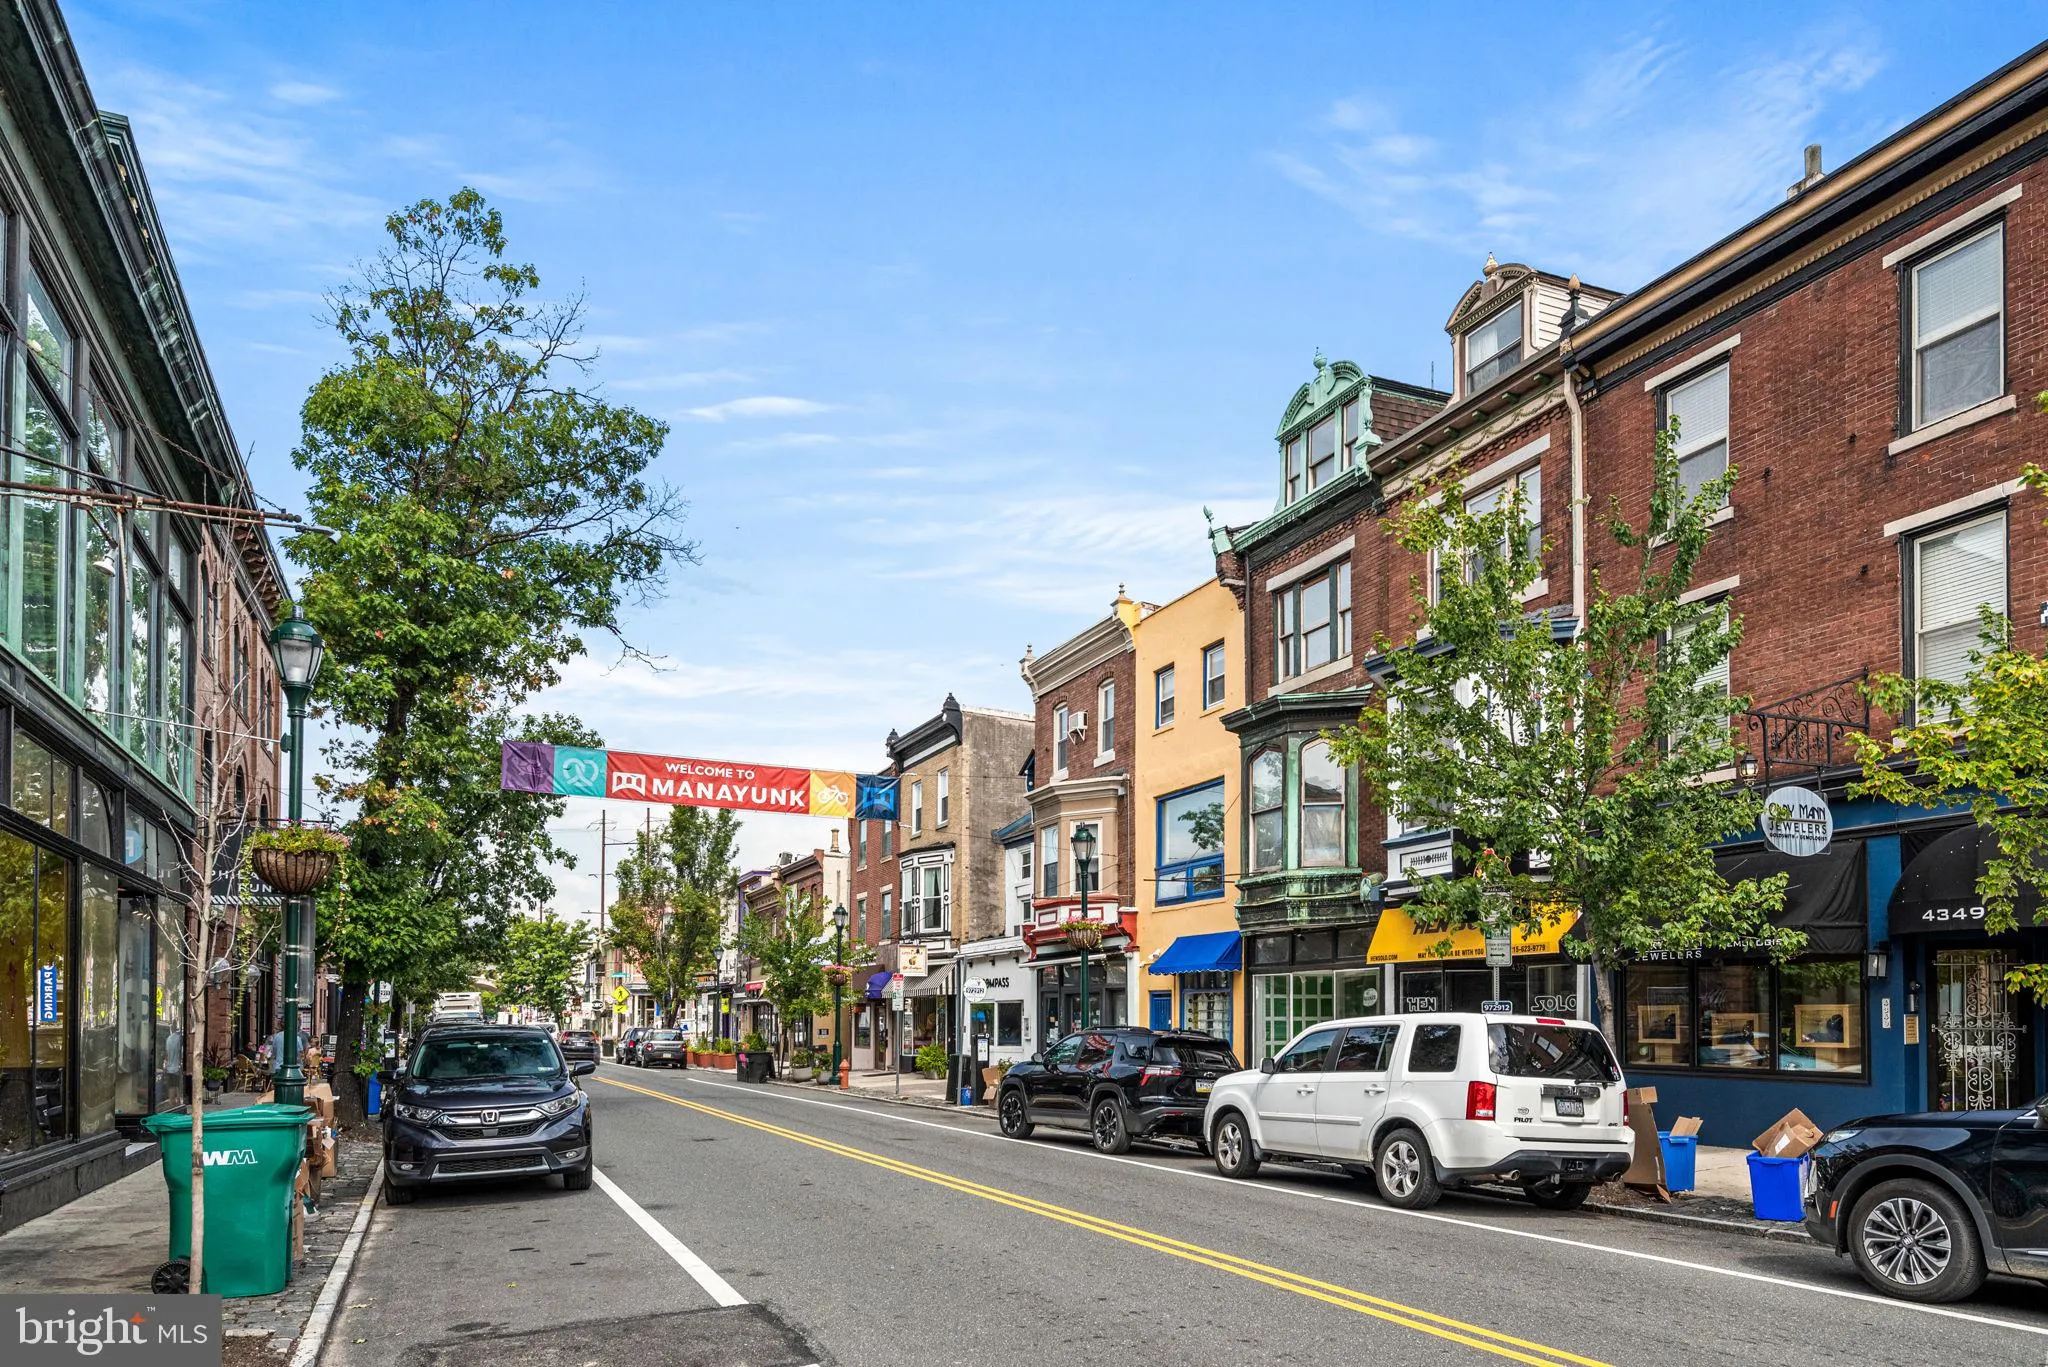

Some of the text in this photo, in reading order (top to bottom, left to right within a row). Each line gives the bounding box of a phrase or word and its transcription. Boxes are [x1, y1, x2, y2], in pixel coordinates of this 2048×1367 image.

[665, 762, 755, 780] WELCOME TO
[652, 778, 806, 807] MANAYUNK
[1769, 820, 1827, 835] JEWELERS
[1922, 906, 1985, 922] 4349
[982, 976, 1010, 989] OMPASS
[1407, 995, 1577, 1012] HEN SOLO
[1483, 1004, 1510, 1012] 972912
[203, 1149, 258, 1166] WM
